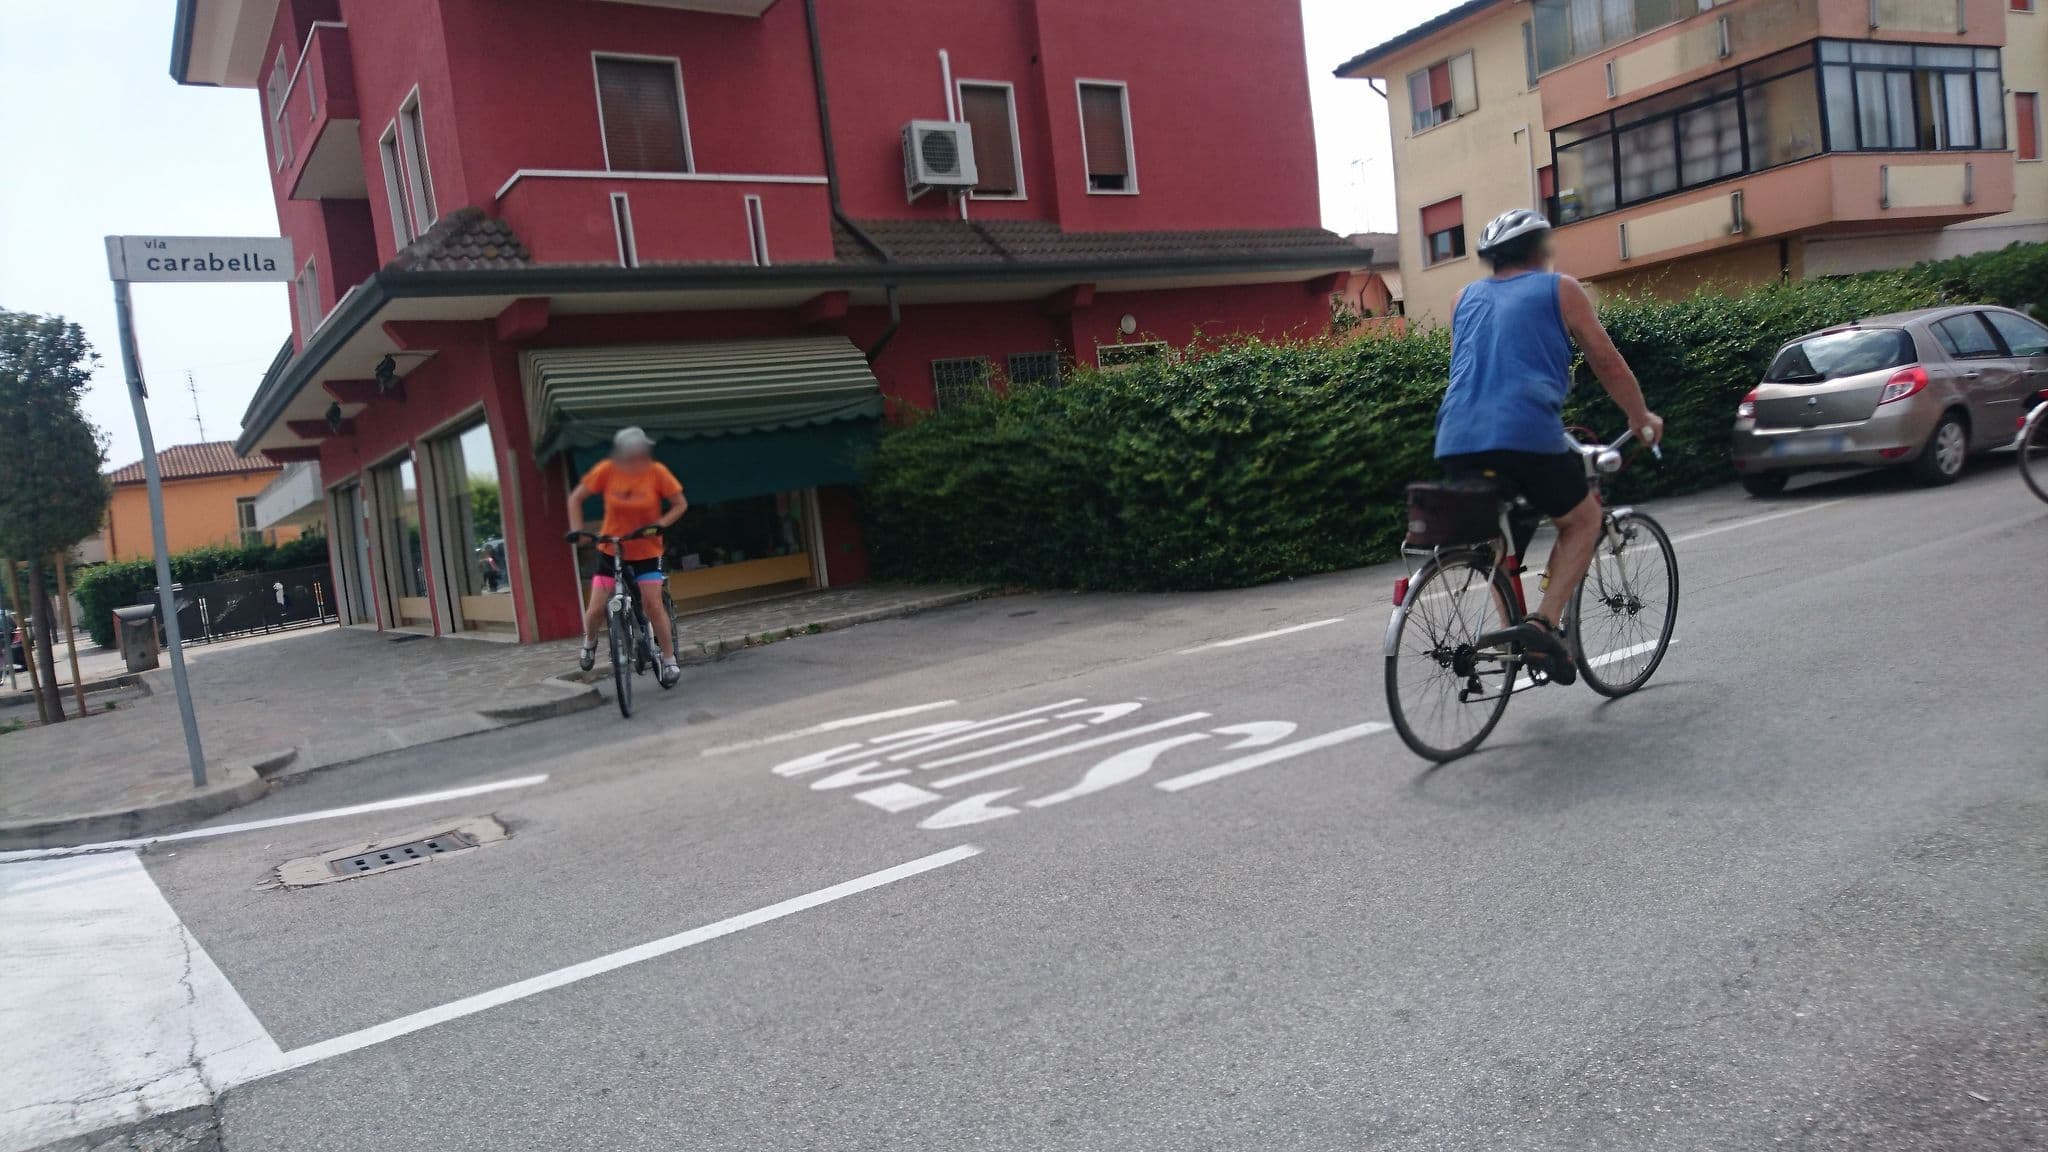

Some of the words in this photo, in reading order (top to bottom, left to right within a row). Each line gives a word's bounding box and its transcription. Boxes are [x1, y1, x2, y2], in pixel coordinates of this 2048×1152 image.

[144, 239, 167, 249] via
[146, 252, 277, 272] carabella
[771, 697, 1299, 831] STOP
